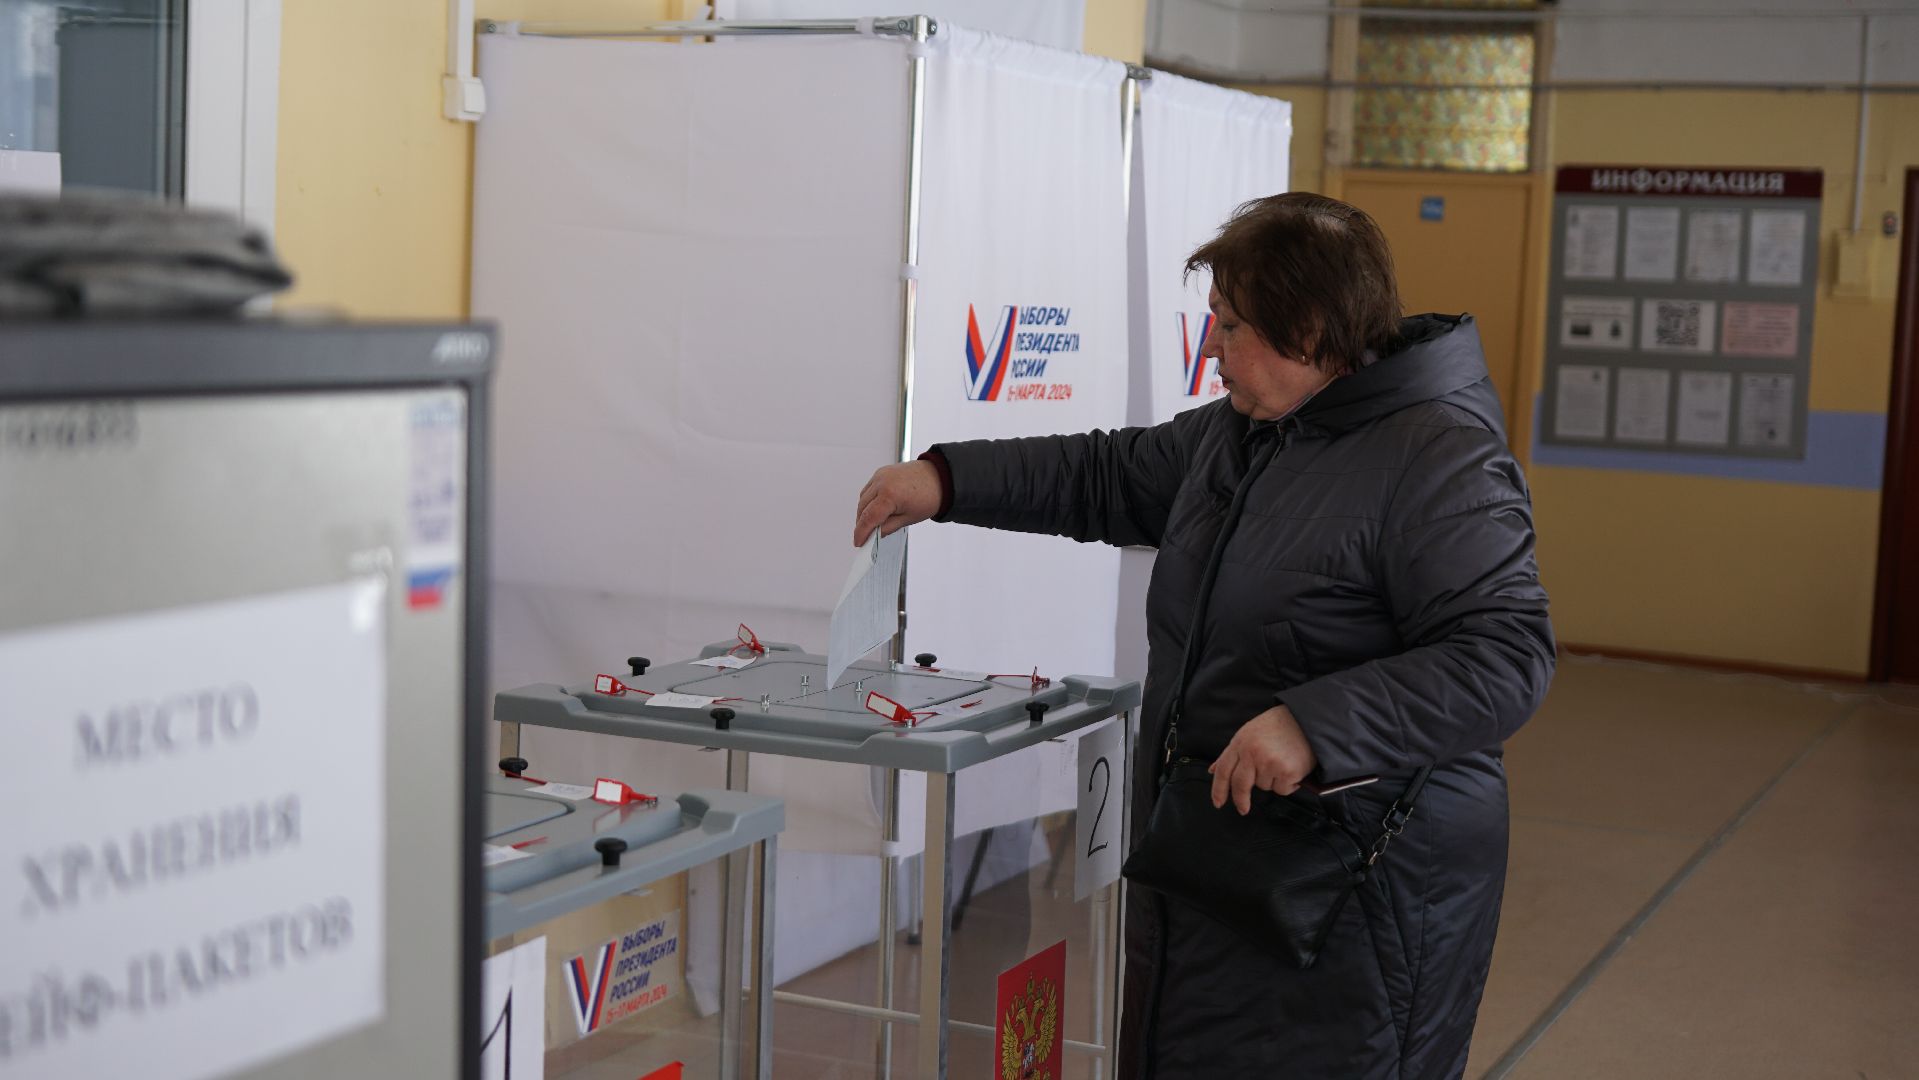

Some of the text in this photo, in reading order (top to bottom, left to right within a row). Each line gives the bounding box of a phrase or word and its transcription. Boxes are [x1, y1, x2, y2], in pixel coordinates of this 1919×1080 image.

[1591, 168, 1785, 194] ИНФОРМАЦИЯ
[1018, 306, 1070, 326] ЫБОРЫ
[1047, 383, 1072, 400] 2024
[74, 682, 259, 771] МЕСТО
[1087, 756, 1110, 858] 2
[622, 920, 665, 953] ВЫБОРЫ
[615, 936, 677, 977] ПРЕЗИДЕНТА
[609, 970, 650, 1003] РОССИИ
